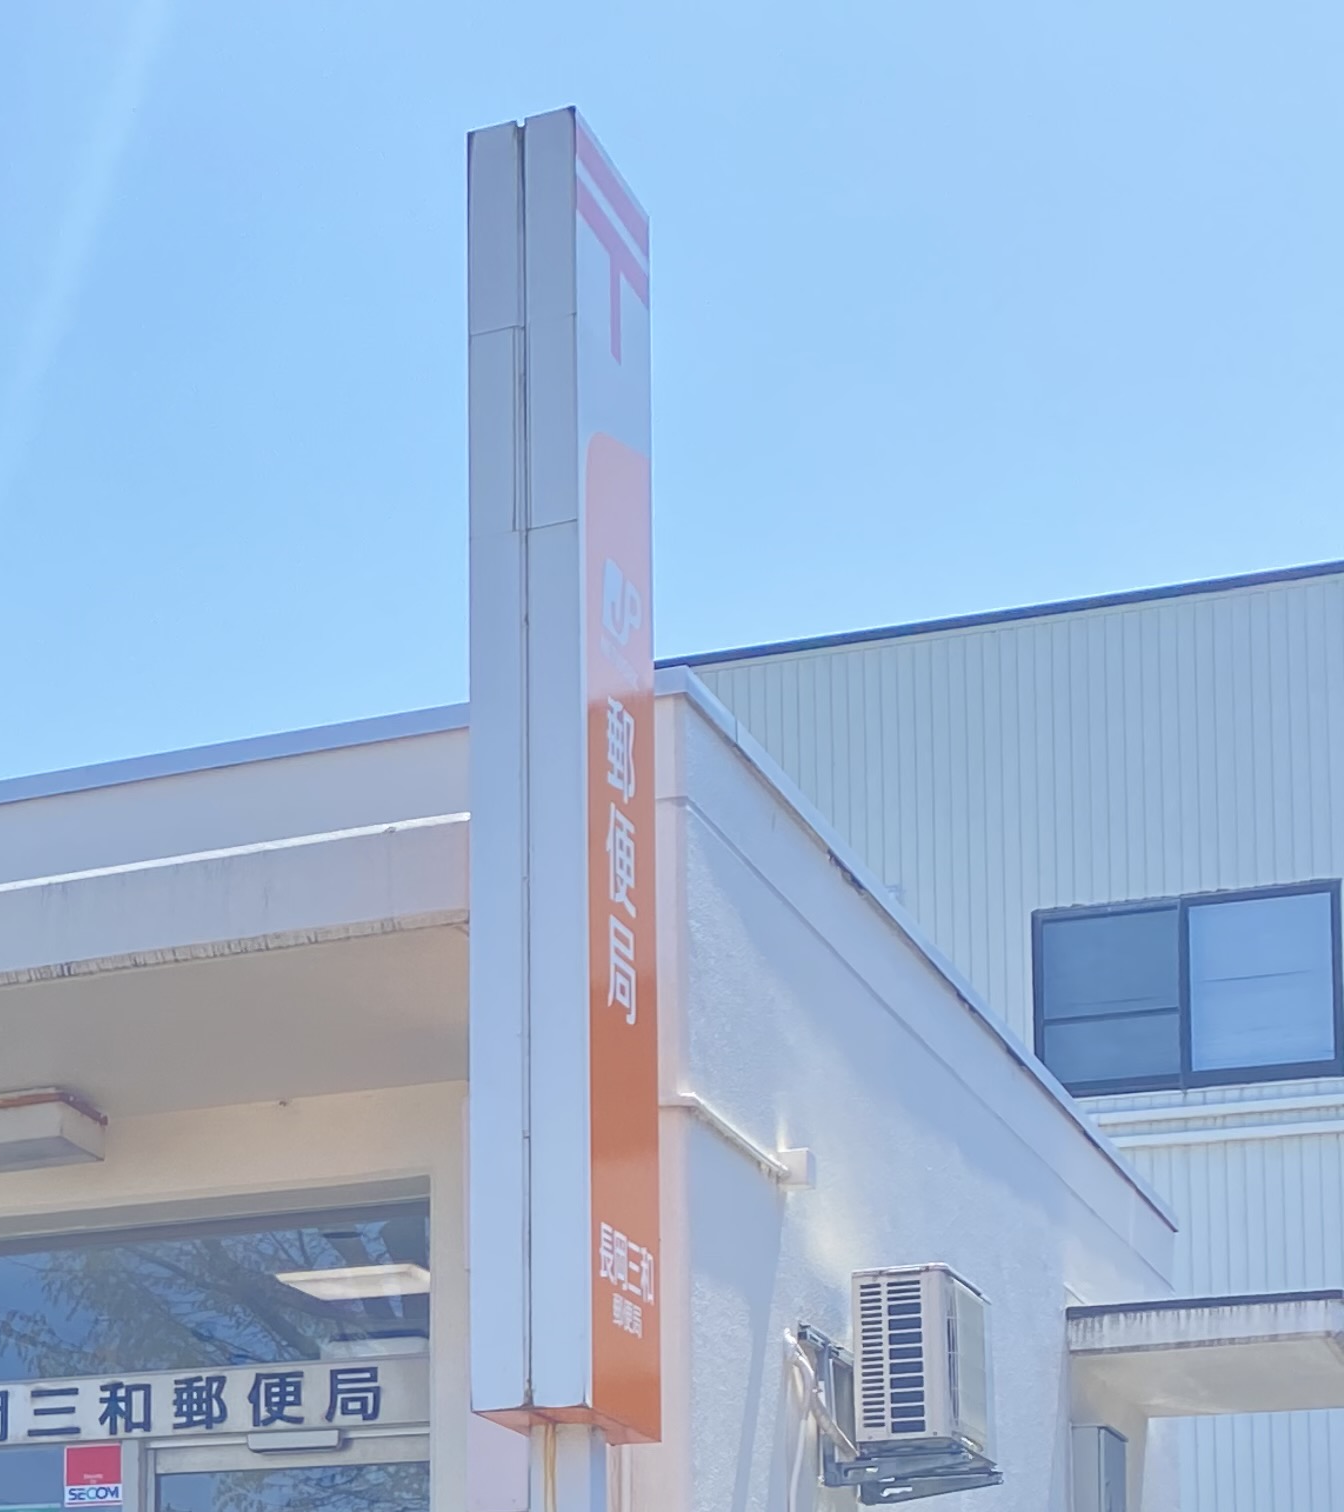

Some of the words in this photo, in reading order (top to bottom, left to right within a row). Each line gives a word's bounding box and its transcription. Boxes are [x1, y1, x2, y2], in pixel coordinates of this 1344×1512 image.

[605, 695, 637, 1026] 郵便局
[599, 1221, 654, 1307] 長岡三和
[612, 1292, 643, 1339] 郵便局
[68, 1486, 119, 1501] SECOM
